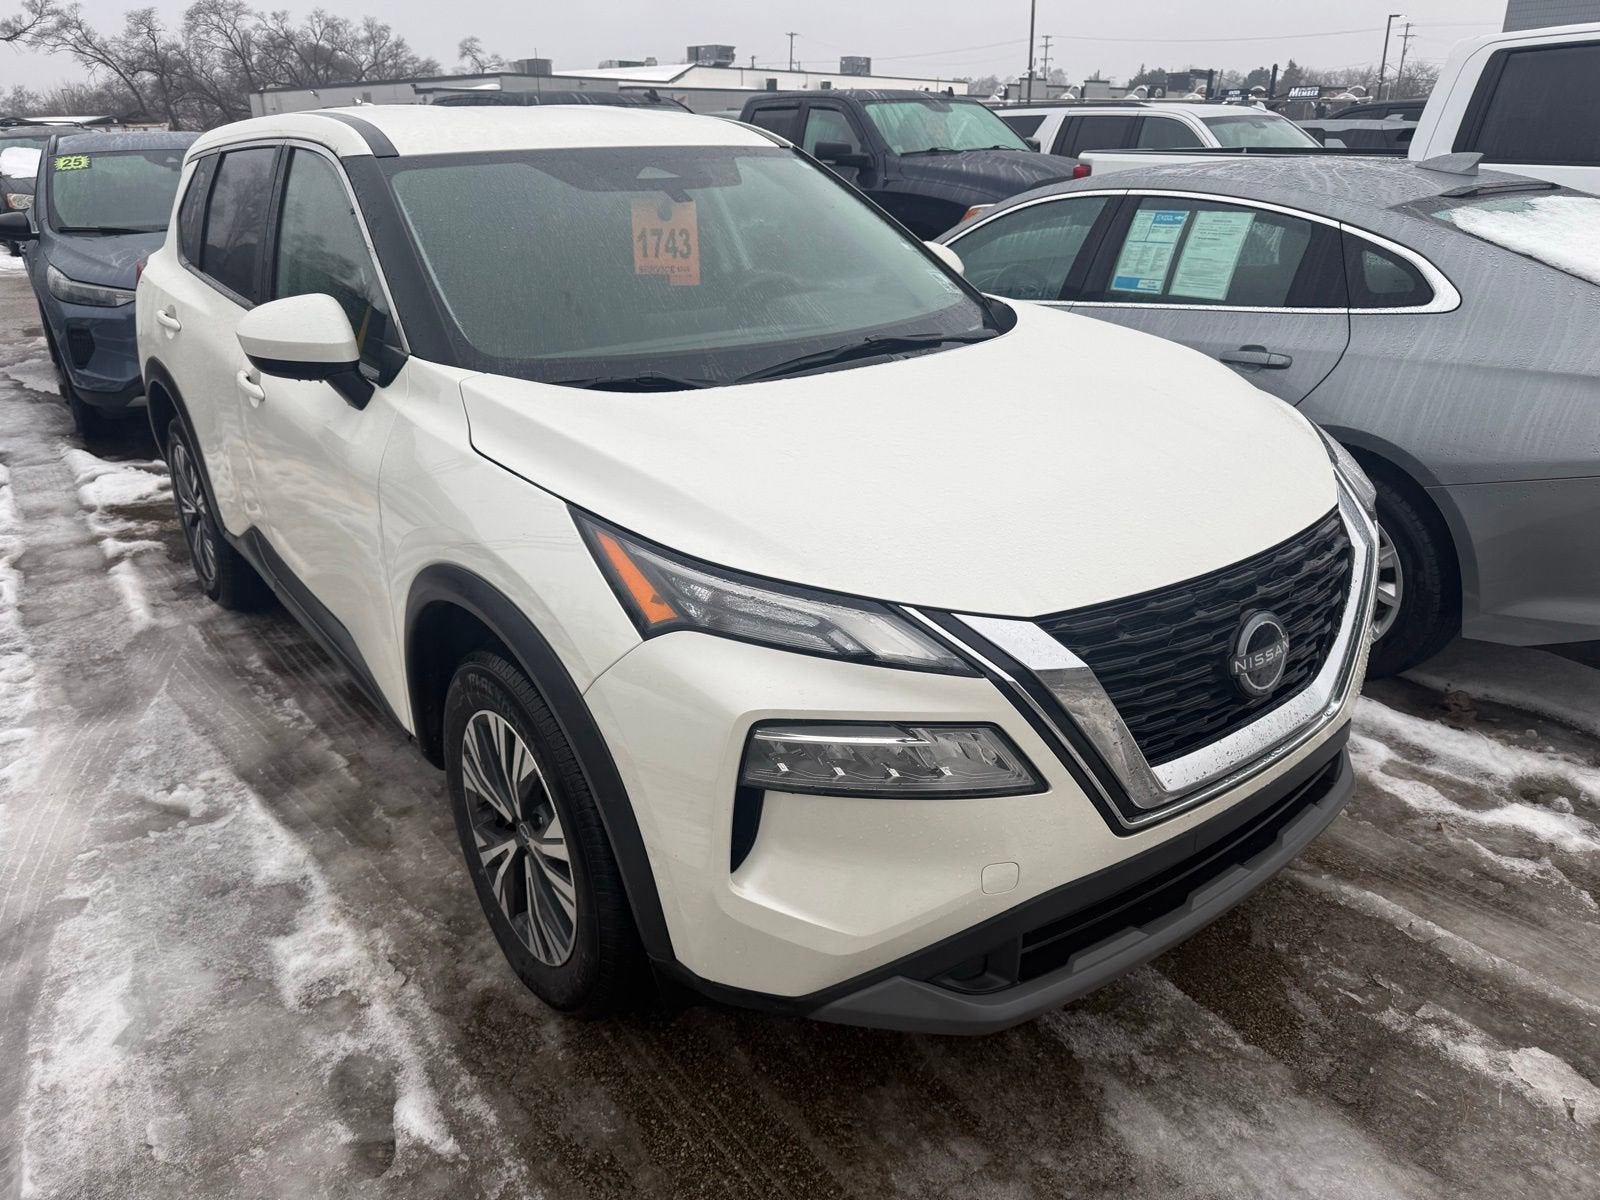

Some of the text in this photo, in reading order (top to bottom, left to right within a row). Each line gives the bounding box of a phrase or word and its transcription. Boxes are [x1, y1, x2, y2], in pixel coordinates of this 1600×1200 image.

[62, 158, 82, 167] 25
[637, 228, 691, 259] 1743
[1234, 631, 1290, 673] NISSAN
